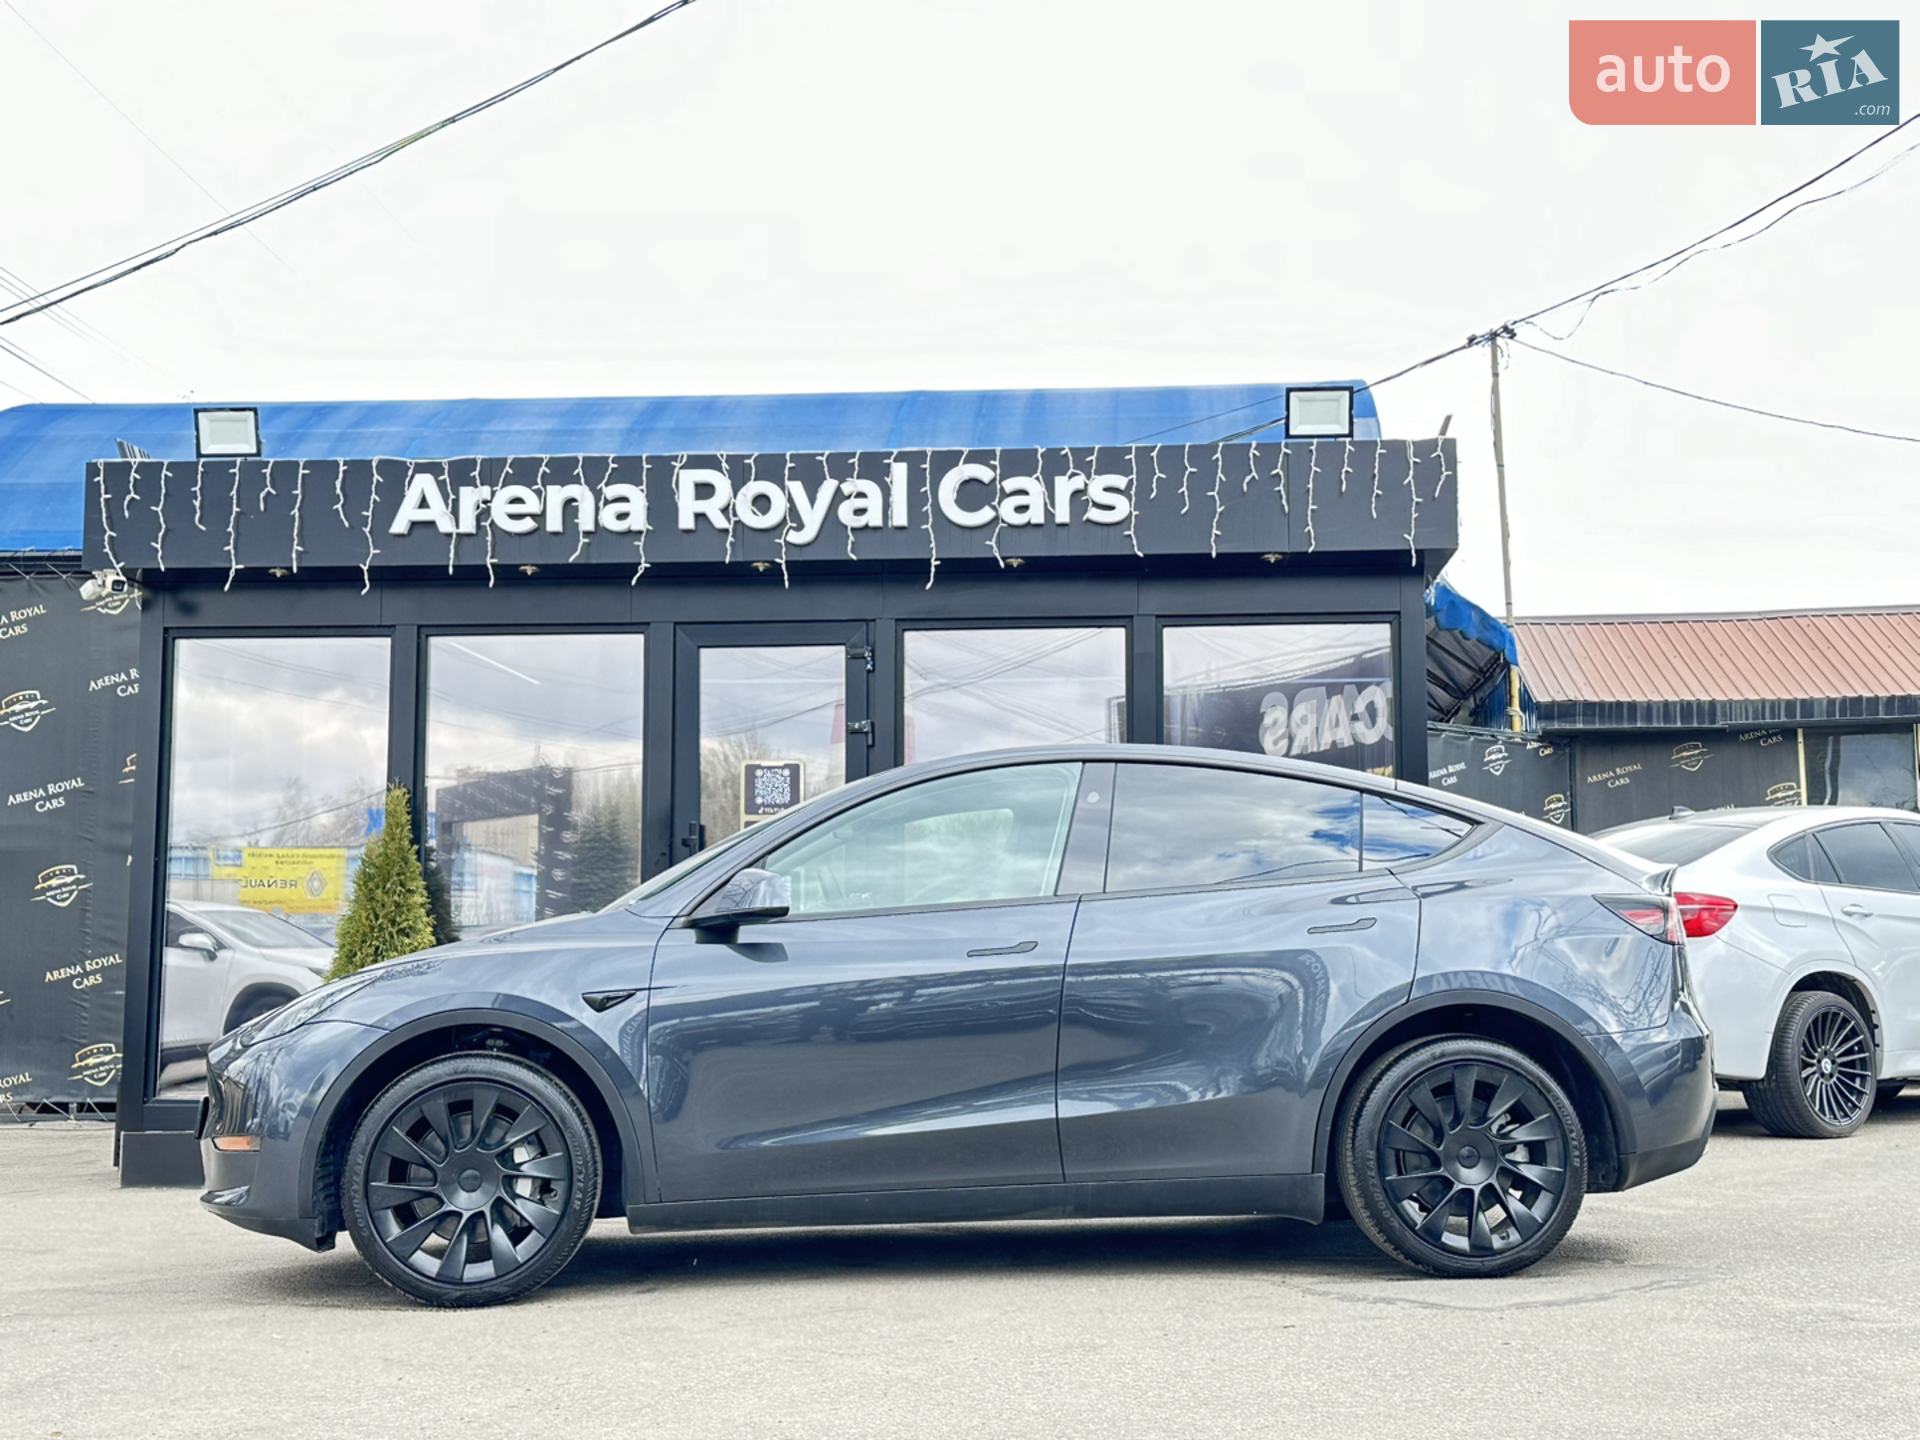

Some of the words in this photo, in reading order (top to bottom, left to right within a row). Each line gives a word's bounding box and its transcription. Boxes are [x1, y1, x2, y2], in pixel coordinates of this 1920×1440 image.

[389, 472, 649, 536] Arena
[677, 461, 909, 546] Royal
[936, 463, 1132, 529] Cars
[10, 604, 48, 622] ROYAL
[0, 623, 28, 639] CARS
[89, 672, 129, 692] ARENA
[1587, 771, 1613, 784] ARENA
[1615, 763, 1643, 775] ROYAL
[1607, 776, 1630, 789] CARS
[8, 788, 46, 806] ARENA
[47, 777, 85, 796] ROYAL
[35, 797, 66, 813] CARS
[45, 966, 83, 983] ARENA
[84, 953, 123, 972] ROYAL
[72, 973, 103, 990] CARS
[1550, 1091, 1581, 1167] GOODYEAR
